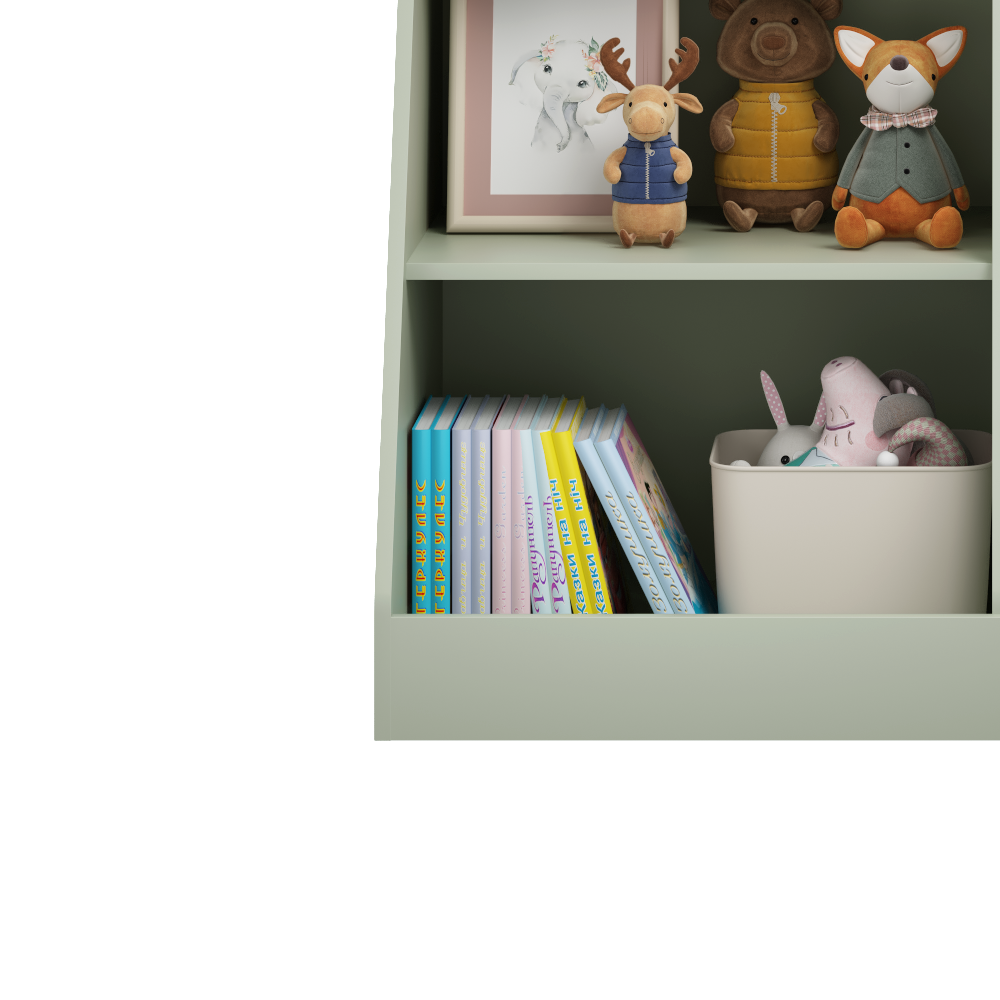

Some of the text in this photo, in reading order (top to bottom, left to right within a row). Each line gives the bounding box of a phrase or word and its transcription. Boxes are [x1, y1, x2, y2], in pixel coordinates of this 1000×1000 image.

[550, 478, 564, 511] ніч
[569, 478, 584, 511] ніч
[416, 479, 426, 614] ГЕРКУЛЕС
[435, 479, 445, 614] ГЕРКУЛЕС
[559, 518, 572, 546] на
[579, 518, 592, 546] на
